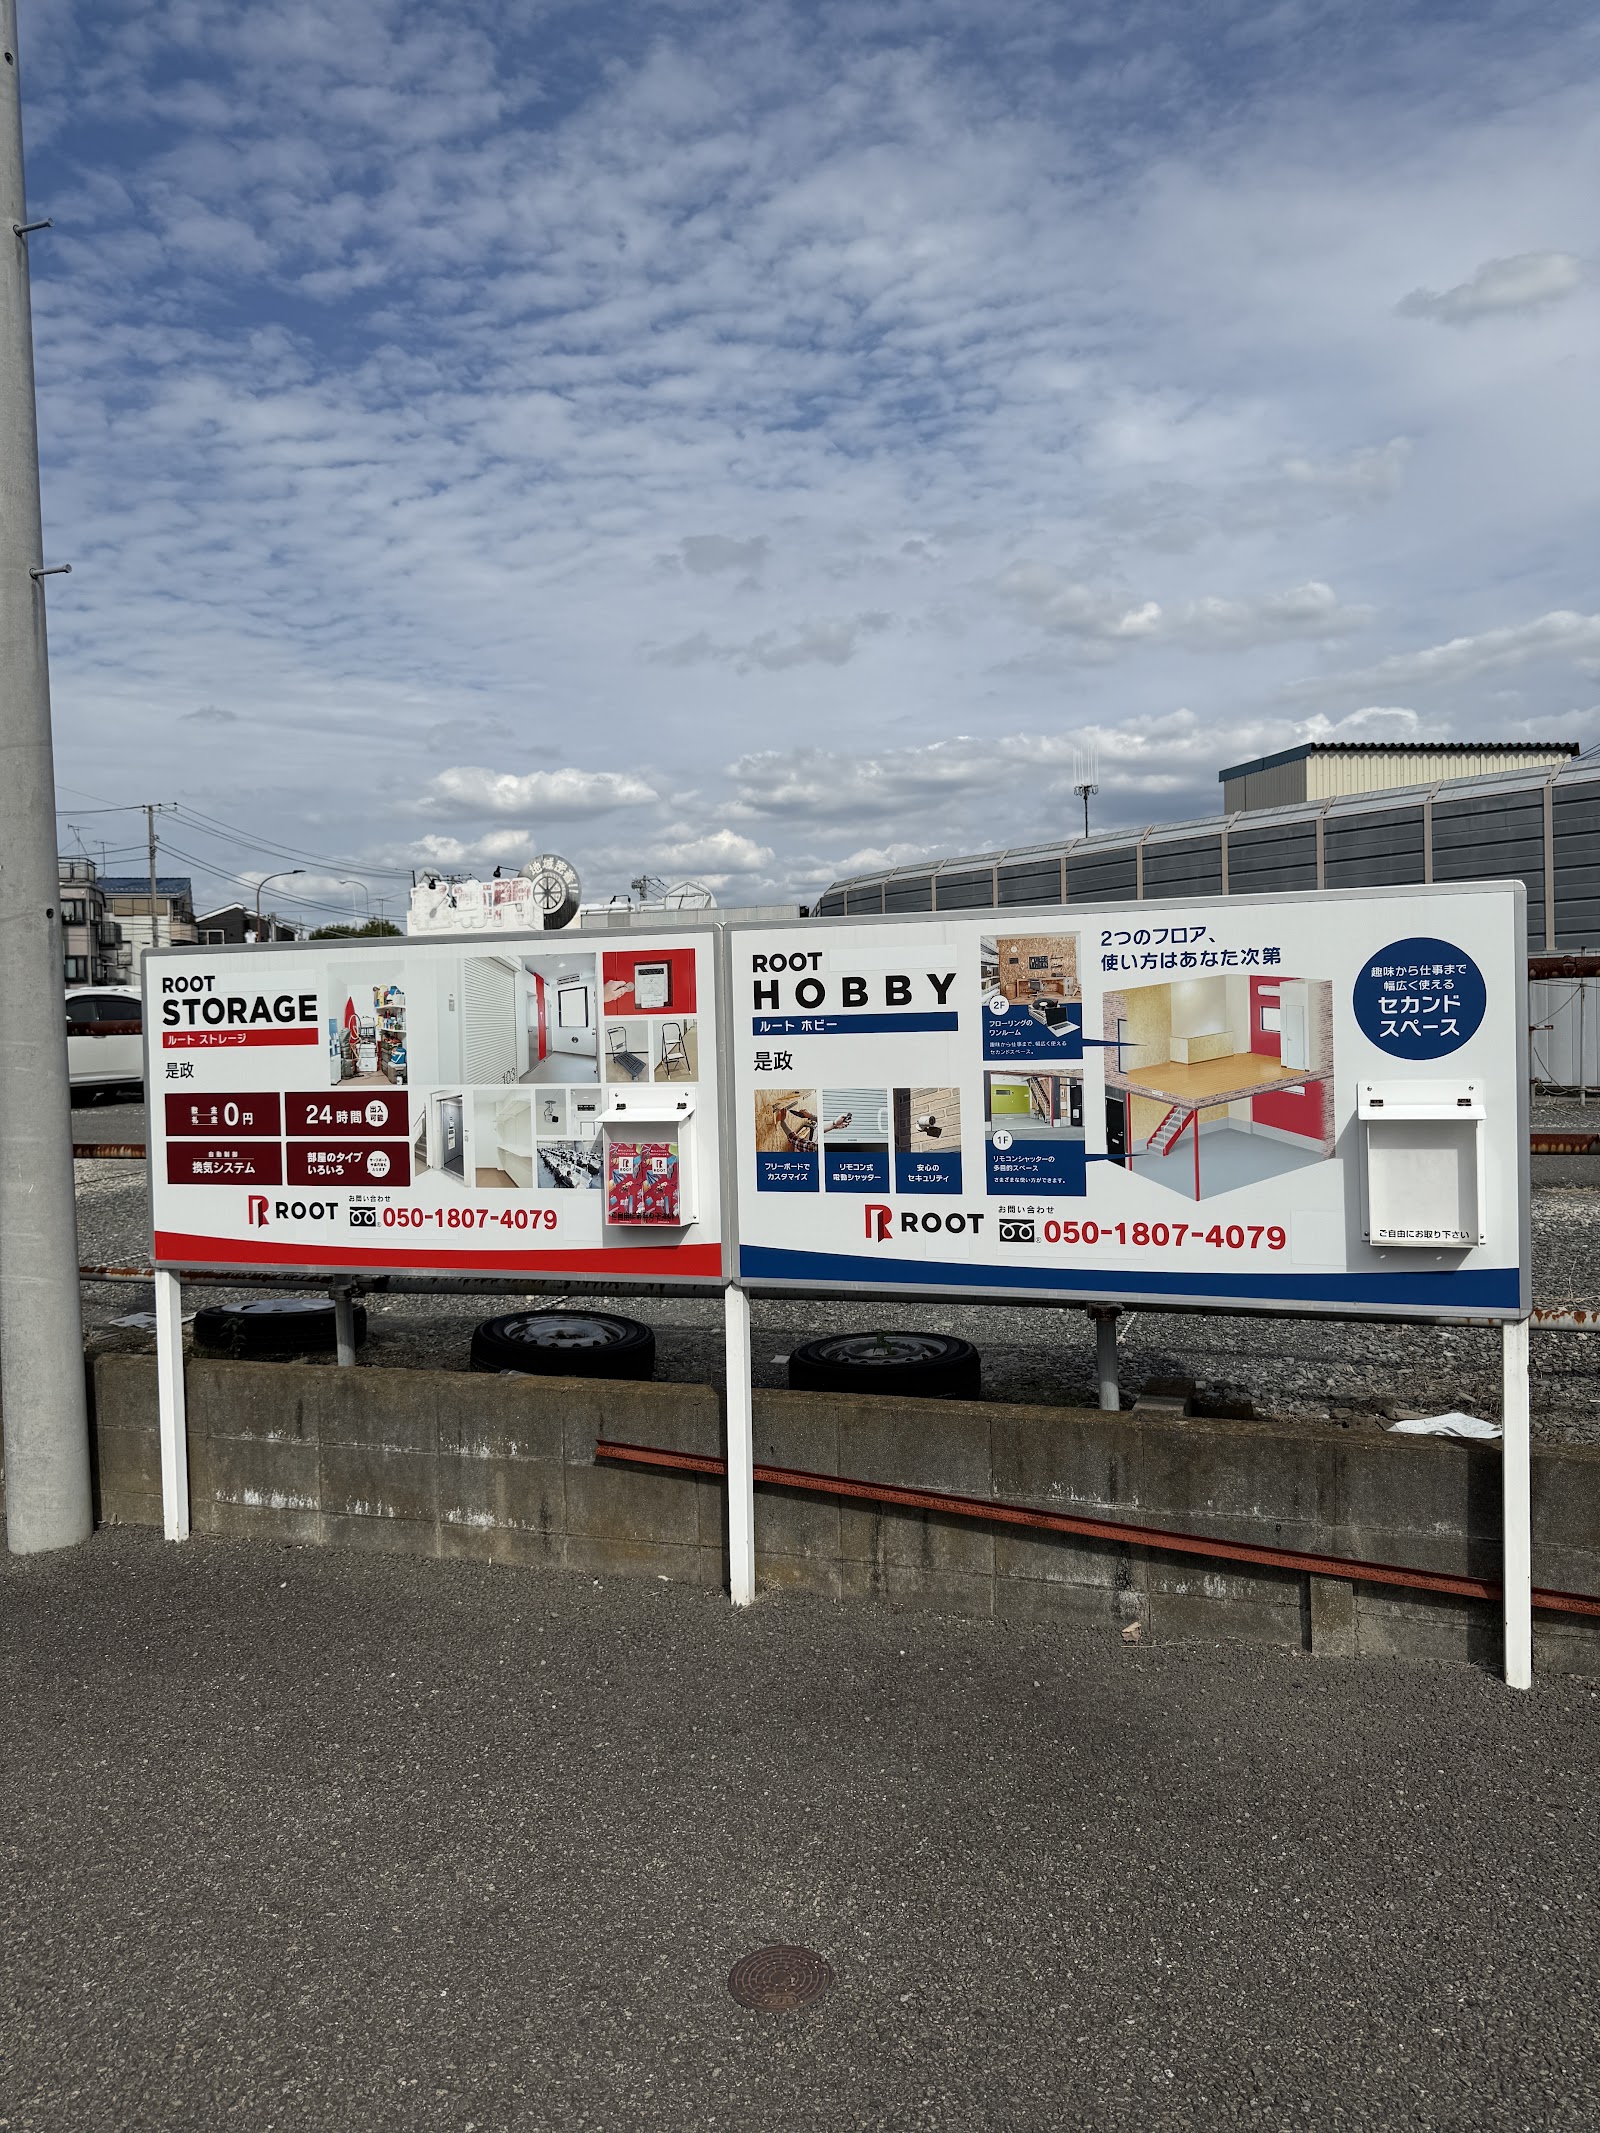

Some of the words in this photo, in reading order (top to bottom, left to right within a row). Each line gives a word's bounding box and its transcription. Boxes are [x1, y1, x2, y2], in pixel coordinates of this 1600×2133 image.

[1101, 926, 1216, 947] 2つのフロア、
[752, 952, 823, 973] ROOT
[1101, 947, 1281, 972] 使い方はあなた次第
[1371, 964, 1467, 978] 趣味から仕事まで
[162, 975, 216, 993] ROOT
[1383, 979, 1455, 992] 幅広く使える
[753, 973, 957, 1010] HOBBY
[162, 994, 318, 1026] STORAGE
[993, 1001, 1006, 1010] 2F
[1378, 994, 1461, 1014] セカンド
[759, 1020, 795, 1033] ルート
[801, 1019, 838, 1031] ホビー
[989, 1019, 1034, 1028] フローリングの
[1379, 1018, 1460, 1038] スペース
[167, 1034, 195, 1046] ルート
[199, 1032, 247, 1045] ストレージ
[989, 1029, 1022, 1037] ワンルーム
[754, 1050, 793, 1071] 是政
[165, 1061, 194, 1080] 是政
[305, 1104, 362, 1124] 24時間
[369, 1105, 384, 1113] 出入
[997, 1136, 1009, 1144] 1F
[307, 1152, 363, 1163] 部屋のタイプ
[192, 1161, 256, 1174] 換気システム
[307, 1165, 344, 1175] いろいろ
[765, 1163, 810, 1171] フリーボードで
[839, 1164, 874, 1172] リモコン式
[917, 1164, 940, 1172] 安心の
[767, 1173, 808, 1181] カスタマイズ
[833, 1174, 882, 1182] 電動シャッター
[908, 1175, 950, 1183] セキュリティ
[275, 1202, 339, 1220] ROOT
[998, 1205, 1055, 1214] お問い合わせ
[382, 1207, 558, 1230] 050-1807-4079
[901, 1212, 985, 1234] ROOT
[1043, 1220, 1287, 1250] 050-1807-4079
[1379, 1229, 1470, 1239] ご自由にお取り下さい
